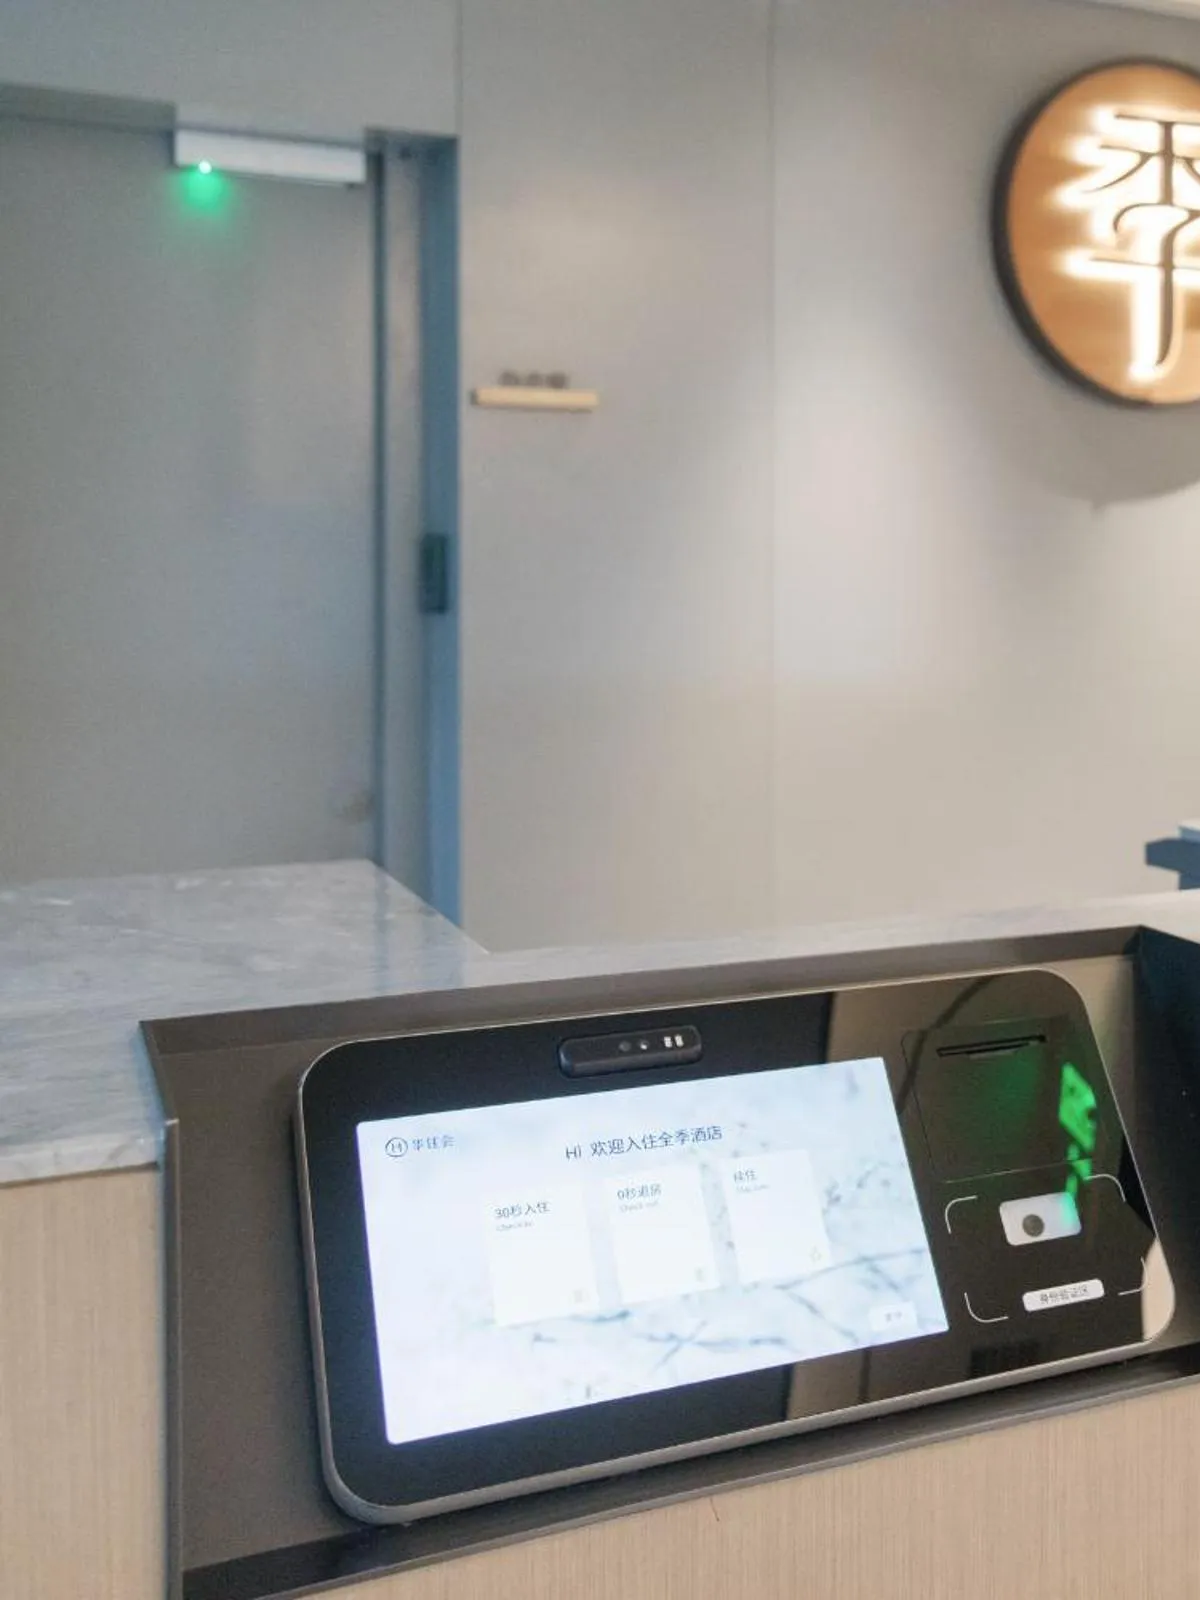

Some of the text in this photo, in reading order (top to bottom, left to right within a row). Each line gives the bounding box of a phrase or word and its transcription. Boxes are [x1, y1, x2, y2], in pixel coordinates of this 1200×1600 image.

[590, 1125, 723, 1158] 欢迎入住全季酒店
